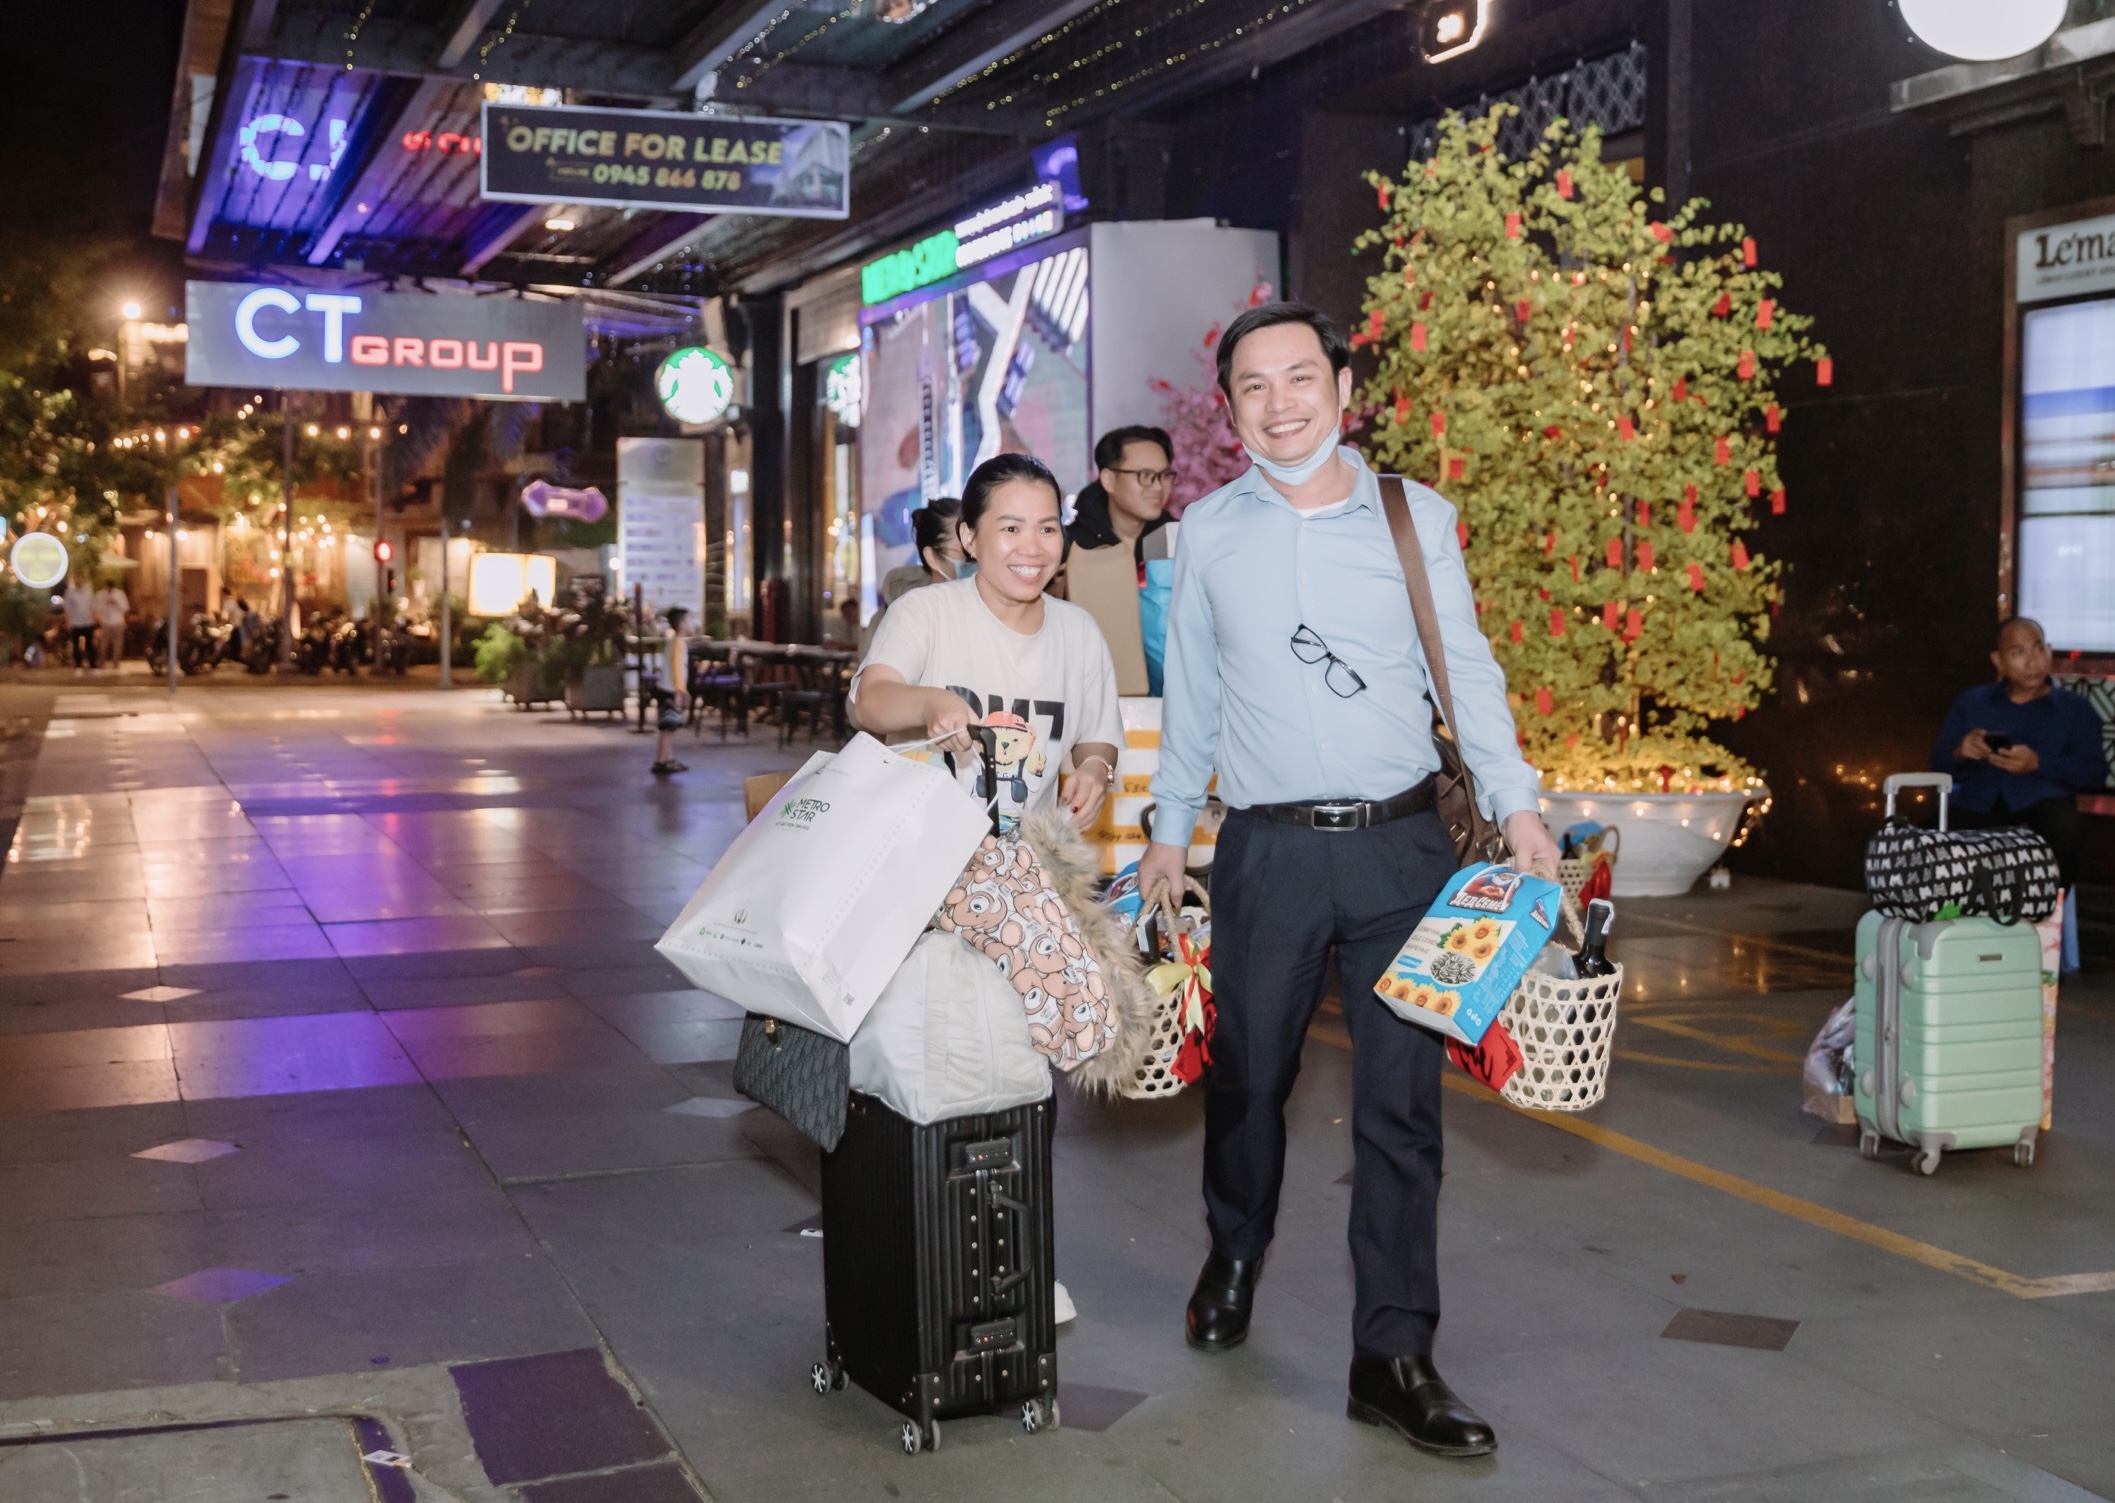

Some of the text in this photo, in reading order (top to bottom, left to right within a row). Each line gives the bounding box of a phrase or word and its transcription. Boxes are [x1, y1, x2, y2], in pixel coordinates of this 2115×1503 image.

[507, 126, 617, 157] OFFICE
[625, 133, 686, 162] FOR
[693, 138, 784, 165] LEASE
[592, 164, 650, 187] 0945
[654, 167, 696, 188] 866
[701, 170, 741, 191] 878
[235, 287, 362, 363] CT
[790, 809, 816, 822] STAR
[796, 798, 831, 813] METRO
